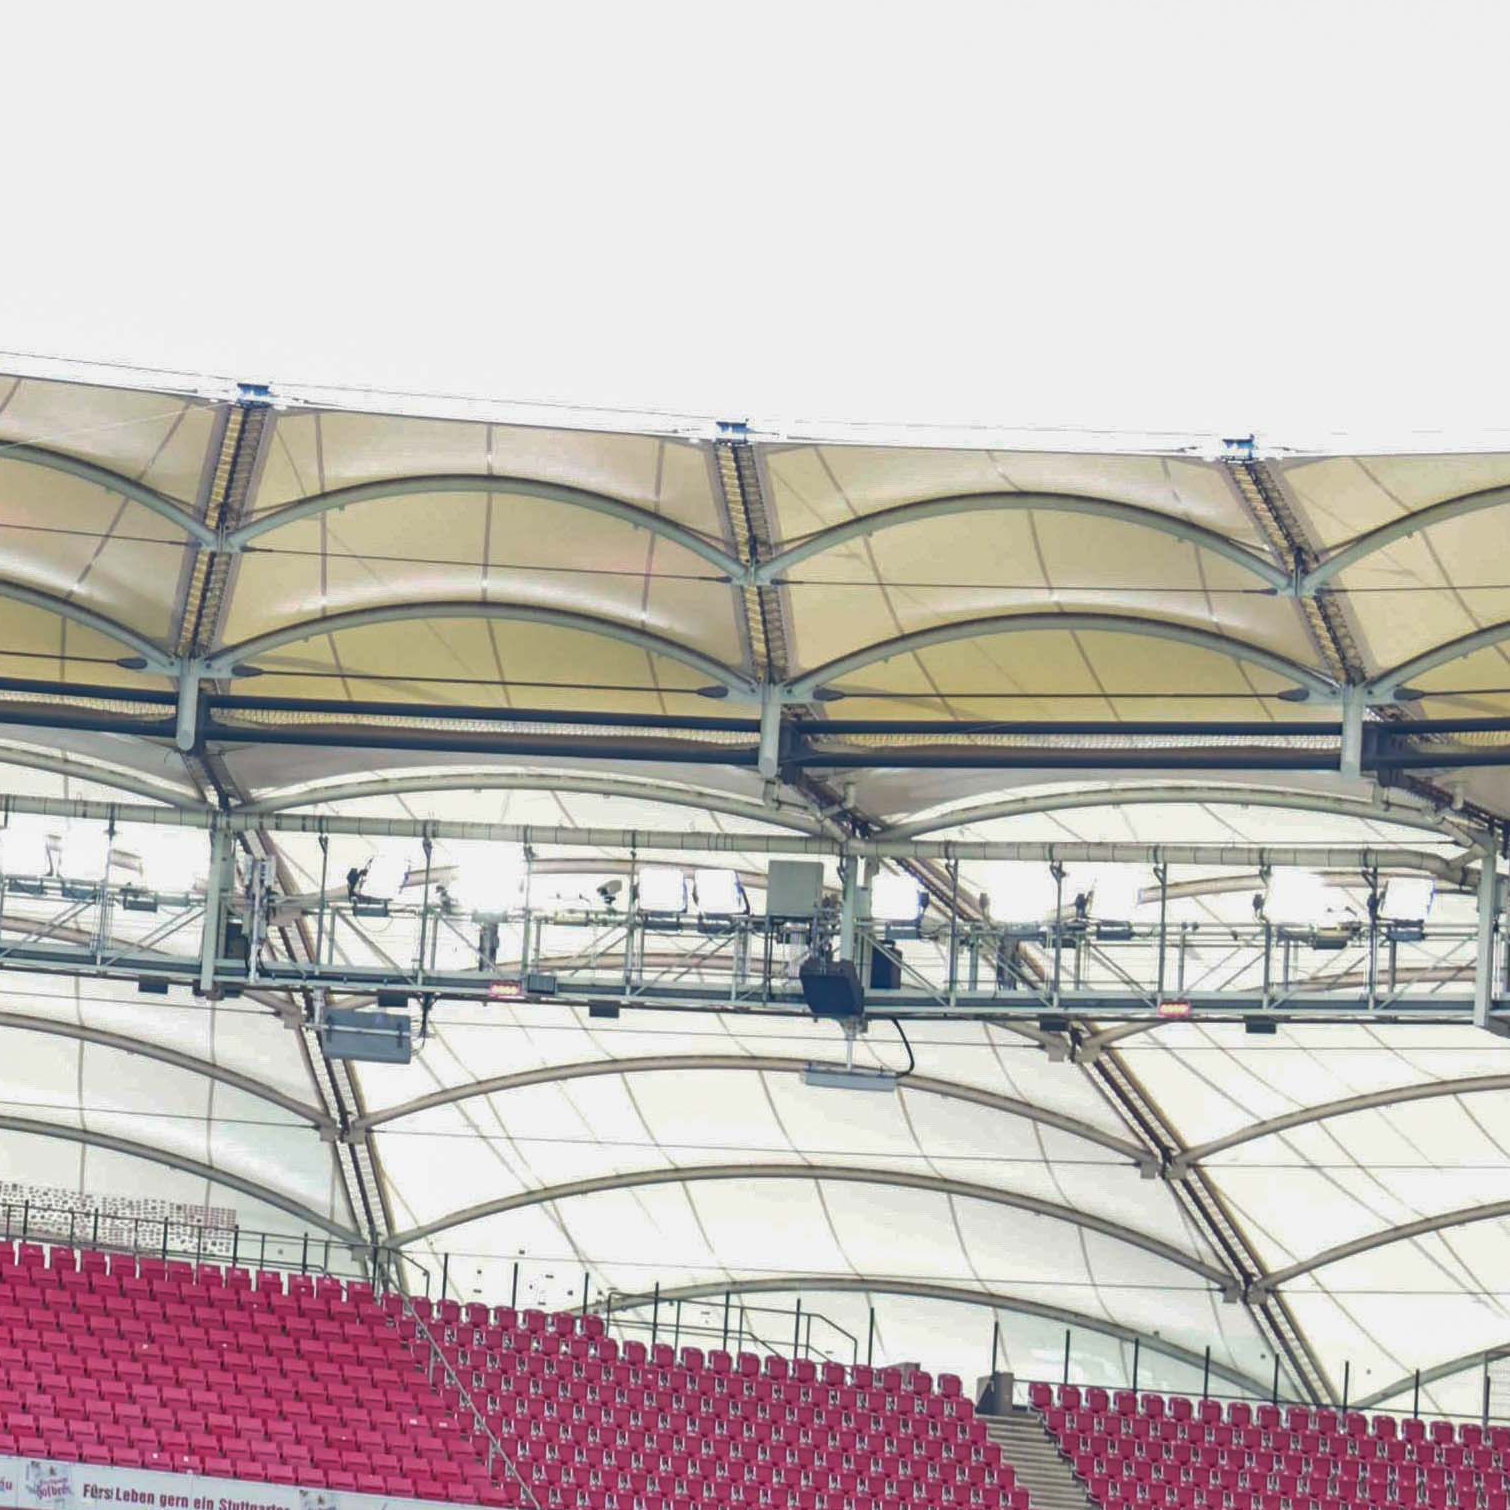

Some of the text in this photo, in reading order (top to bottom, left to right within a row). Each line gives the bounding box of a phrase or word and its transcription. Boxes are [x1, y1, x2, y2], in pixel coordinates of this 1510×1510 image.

[83, 1483, 113, 1500] Fürs
[115, 1487, 155, 1506] Leben
[160, 1493, 189, 1510] gern
